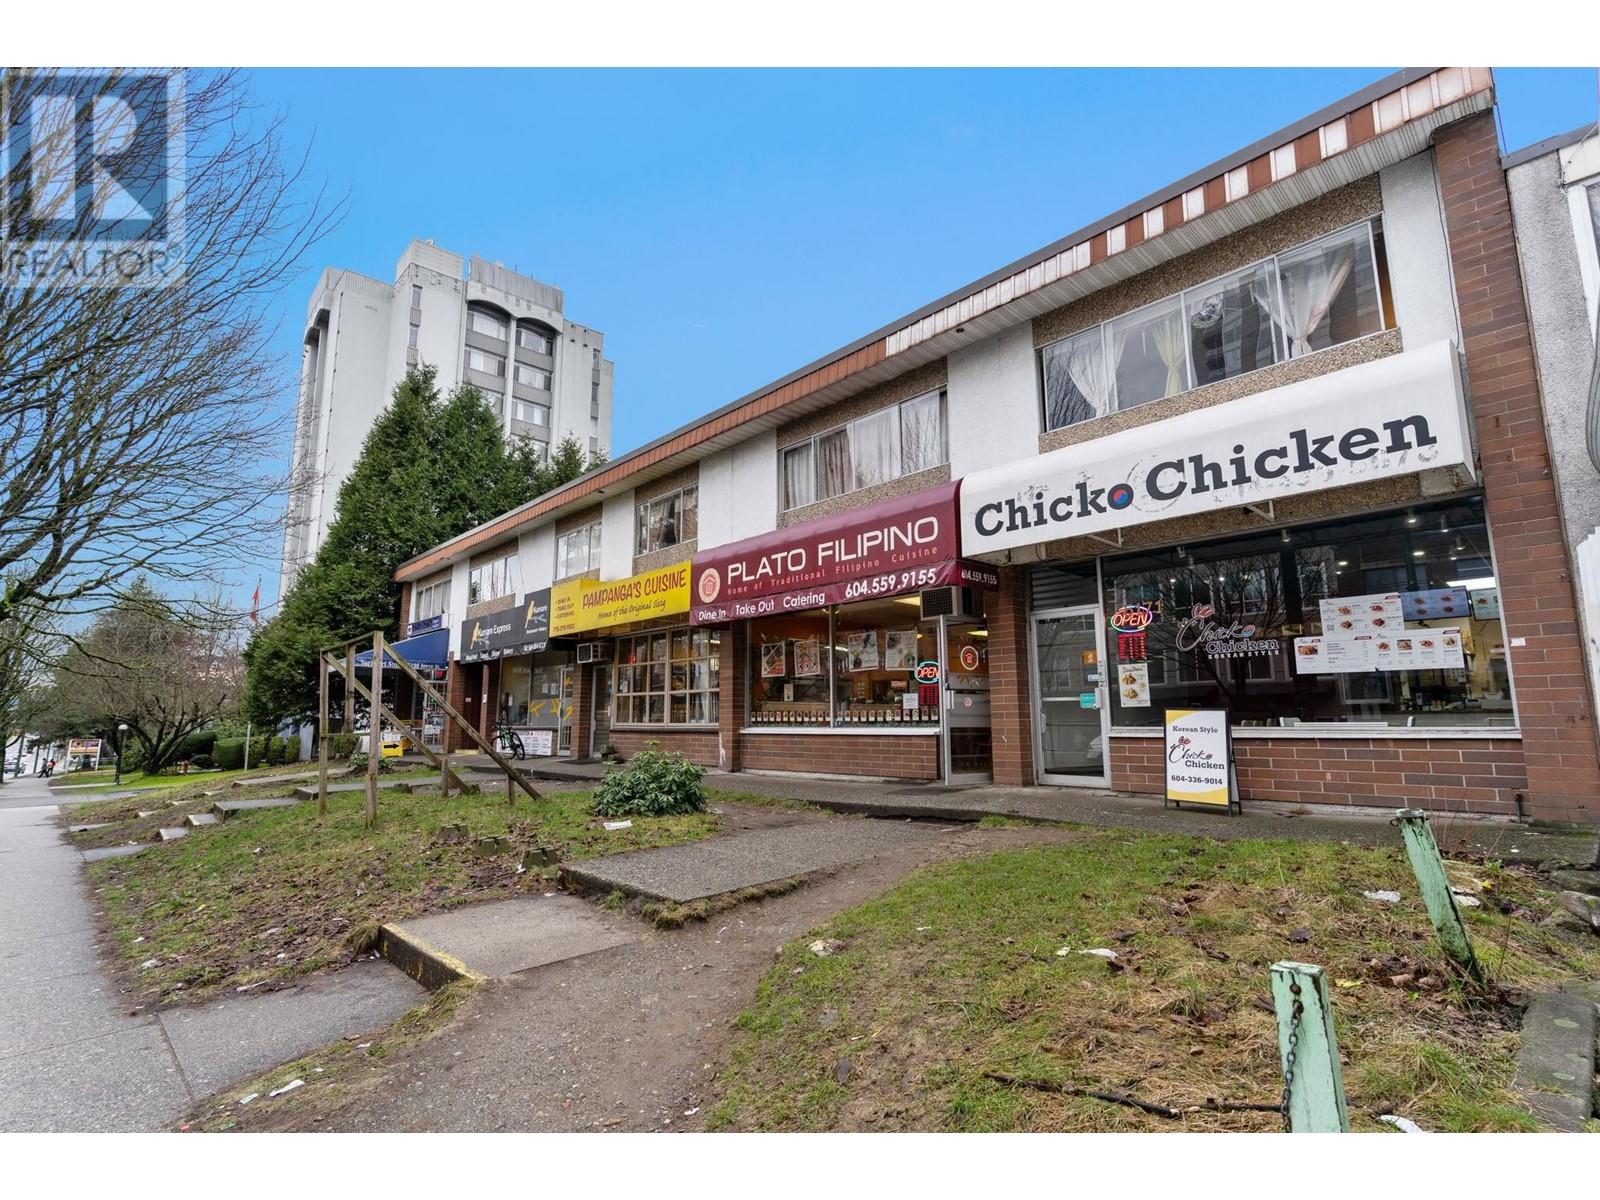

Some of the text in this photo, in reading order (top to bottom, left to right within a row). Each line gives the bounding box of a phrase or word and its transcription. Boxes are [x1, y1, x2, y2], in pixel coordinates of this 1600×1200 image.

[974, 412, 1438, 538] Chicko Chicken
[727, 516, 939, 585] PLATO FILIPINO
[727, 546, 938, 595] Home of Traditional Filipino Cuisine
[961, 569, 998, 585] 604.559.9155
[583, 568, 687, 610] PAMPANGA'S CUISINE
[699, 568, 936, 621] Dine In Take Out Catering 604.559.9155
[628, 600, 651, 616] Original
[1113, 612, 1148, 627] OPEN
[1205, 638, 1279, 654] Chicken
[917, 666, 939, 678] OPEN
[1172, 725, 1218, 734] Korean Style
[1185, 760, 1225, 770] Chicken
[1171, 775, 1223, 785] 604-336-9014
